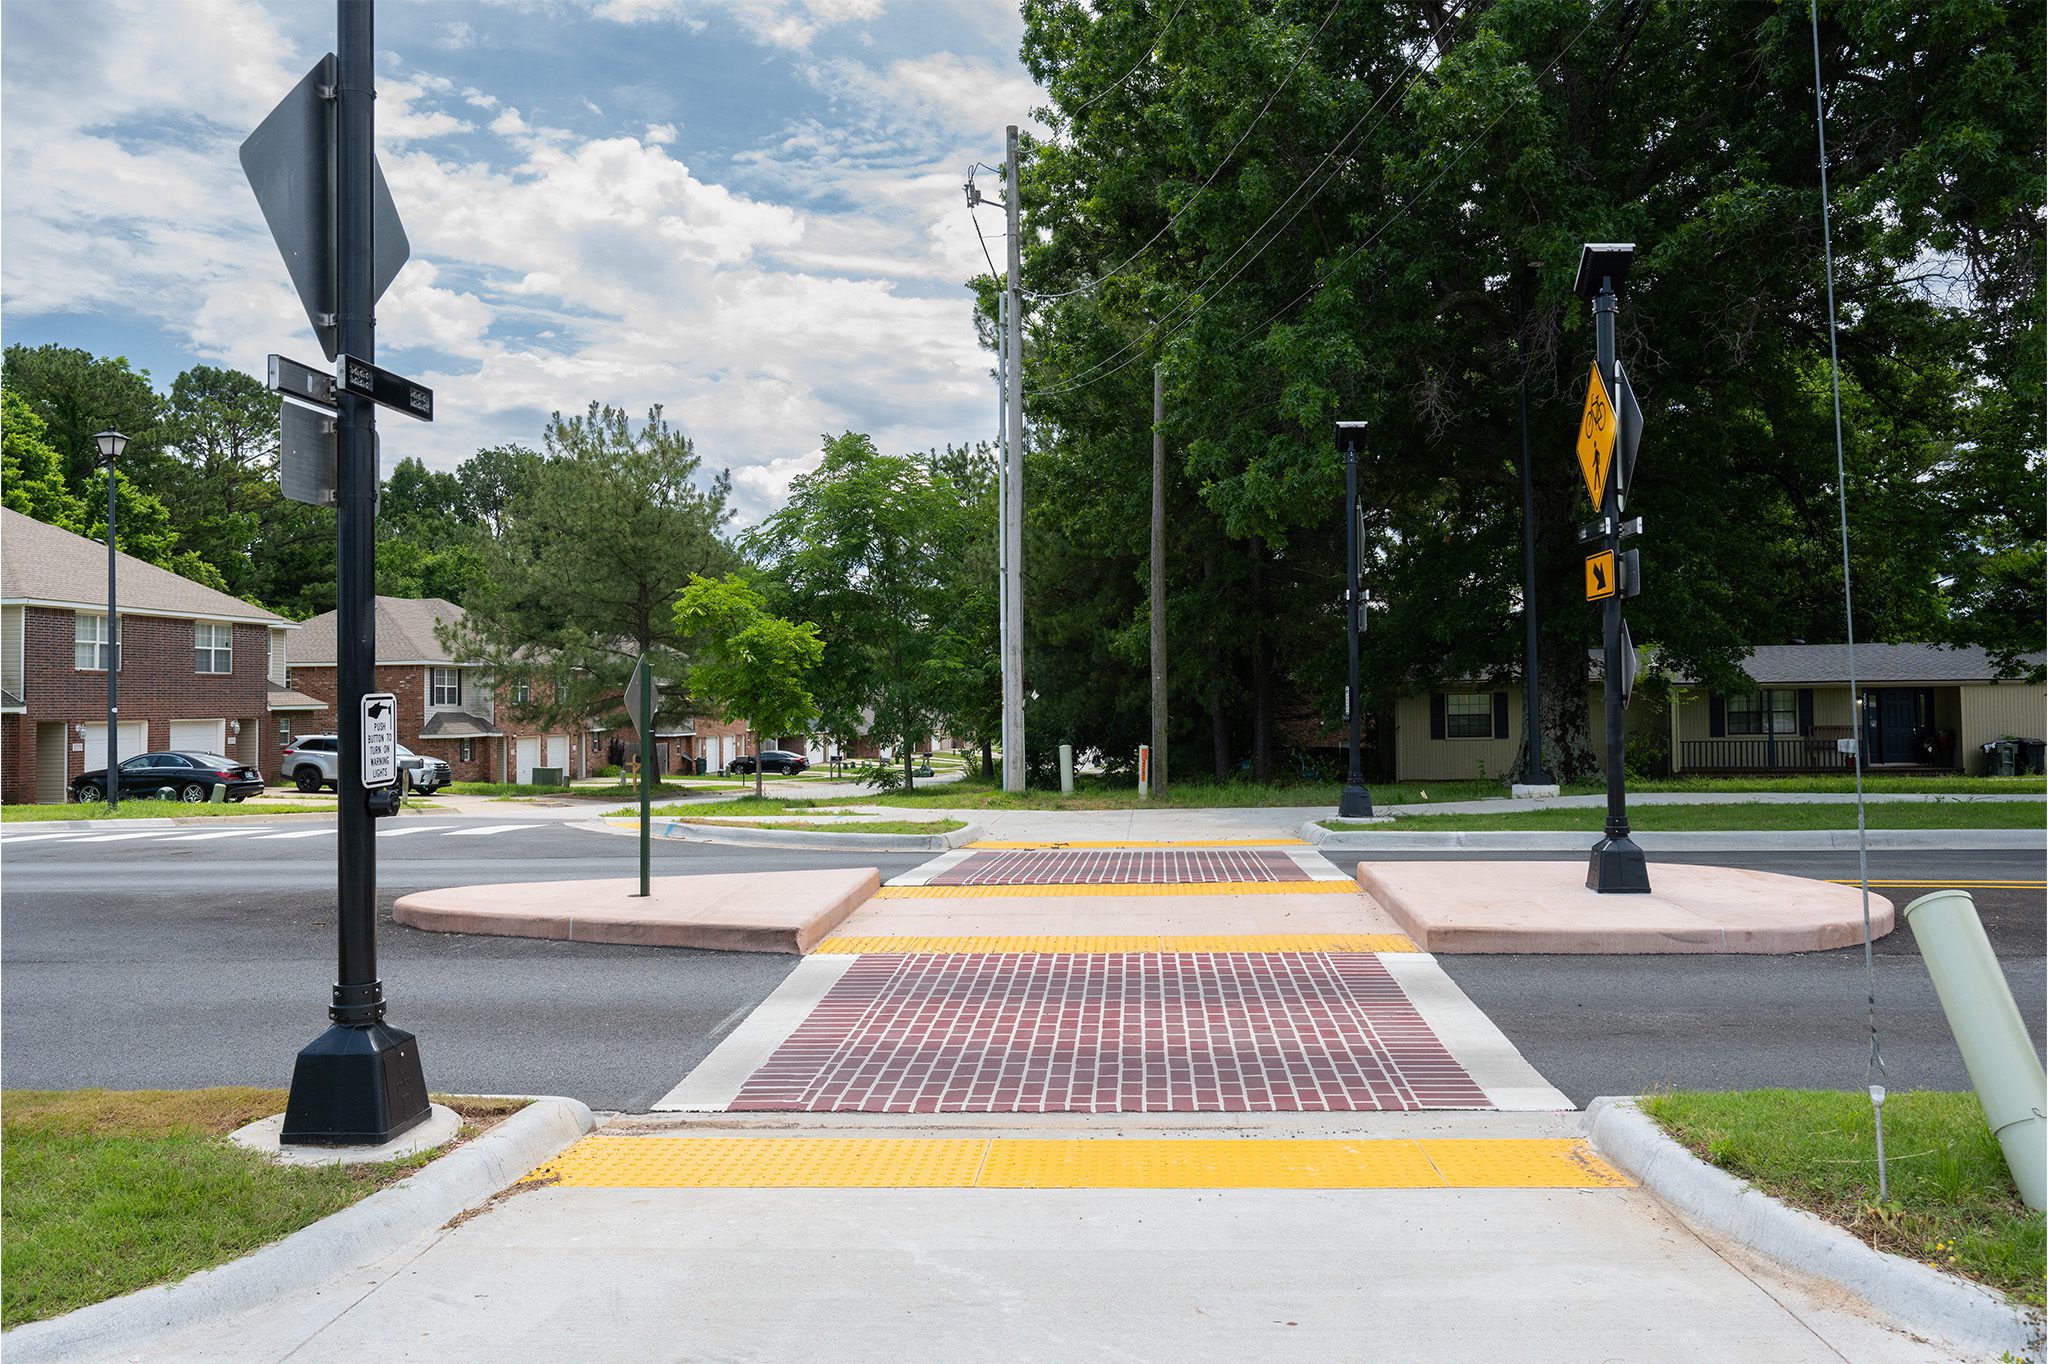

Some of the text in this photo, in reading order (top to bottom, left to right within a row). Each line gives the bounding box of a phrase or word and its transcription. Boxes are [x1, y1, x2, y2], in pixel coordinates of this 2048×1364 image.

[374, 722, 386, 732] PUSH
[368, 733, 393, 744] BUTTON TO
[370, 745, 391, 755] TURN ON
[370, 756, 390, 767] WARNING
[372, 768, 388, 779] LIGHTS
